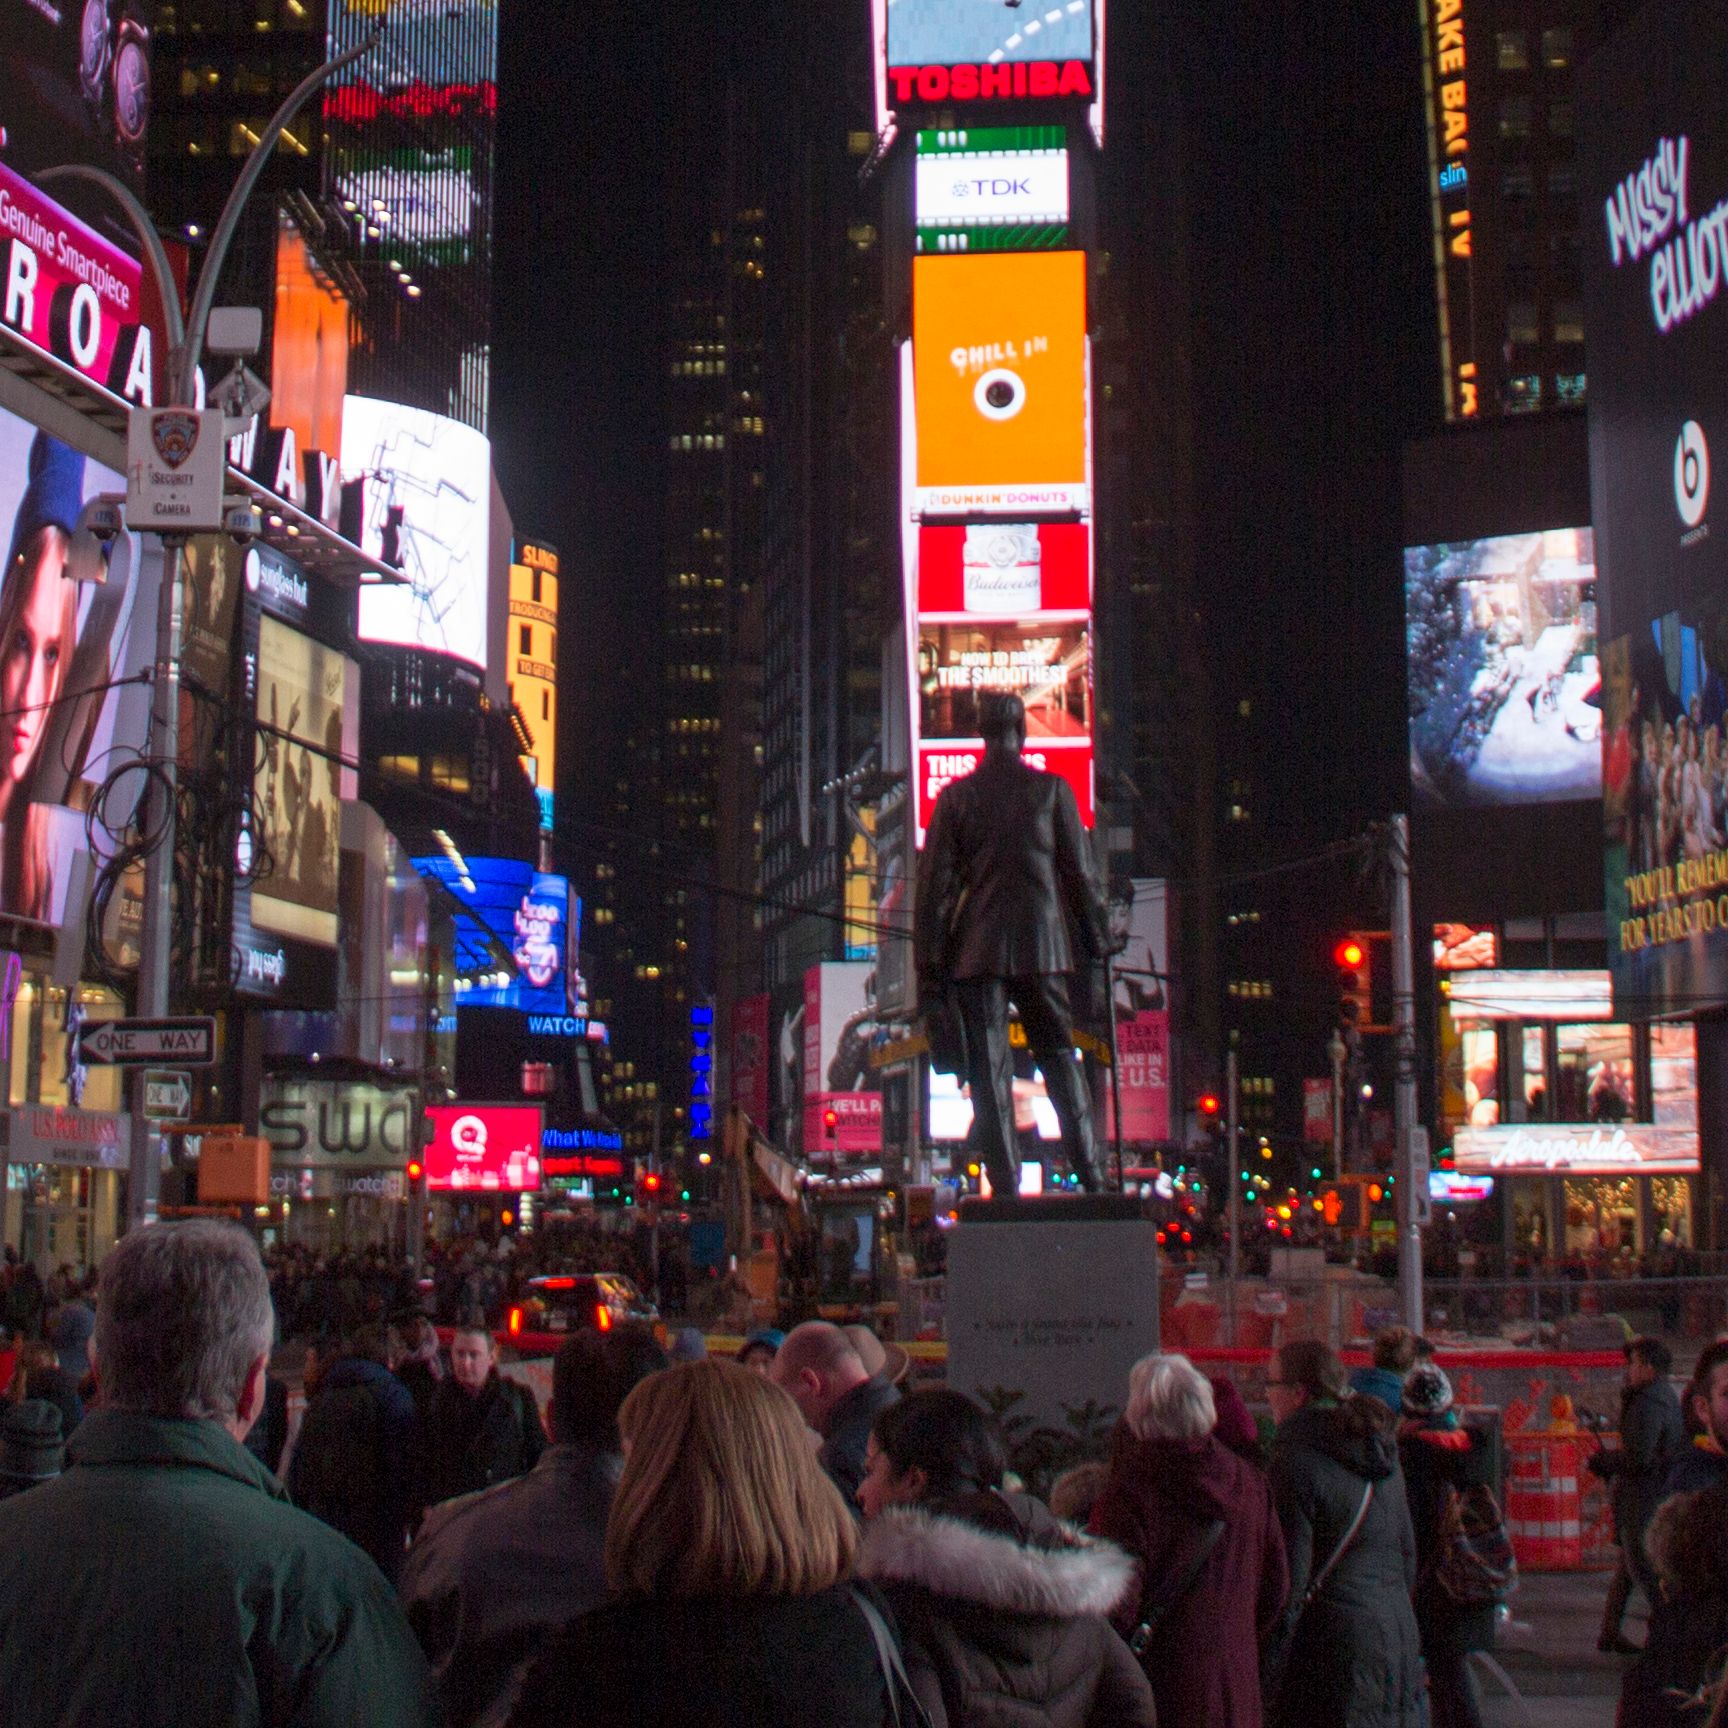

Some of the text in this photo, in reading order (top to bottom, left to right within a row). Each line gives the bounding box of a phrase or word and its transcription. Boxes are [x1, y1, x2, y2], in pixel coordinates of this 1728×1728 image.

[887, 59, 1092, 103] TOSHIBA
[970, 177, 1031, 196] TDK
[56, 234, 130, 310] Smartpiece
[949, 335, 1049, 369] CHILL IN
[151, 473, 194, 486] SECURITY
[1006, 490, 1069, 505] DONUTS
[153, 502, 191, 516] CAMERA
[967, 573, 1039, 593] Budweiser
[937, 664, 1070, 686] THE SMOOTHEST
[926, 754, 978, 775] THIS
[1619, 901, 1693, 952] FOR YEARS
[527, 1015, 587, 1036] WATCH
[96, 1030, 202, 1051] ONE WAY
